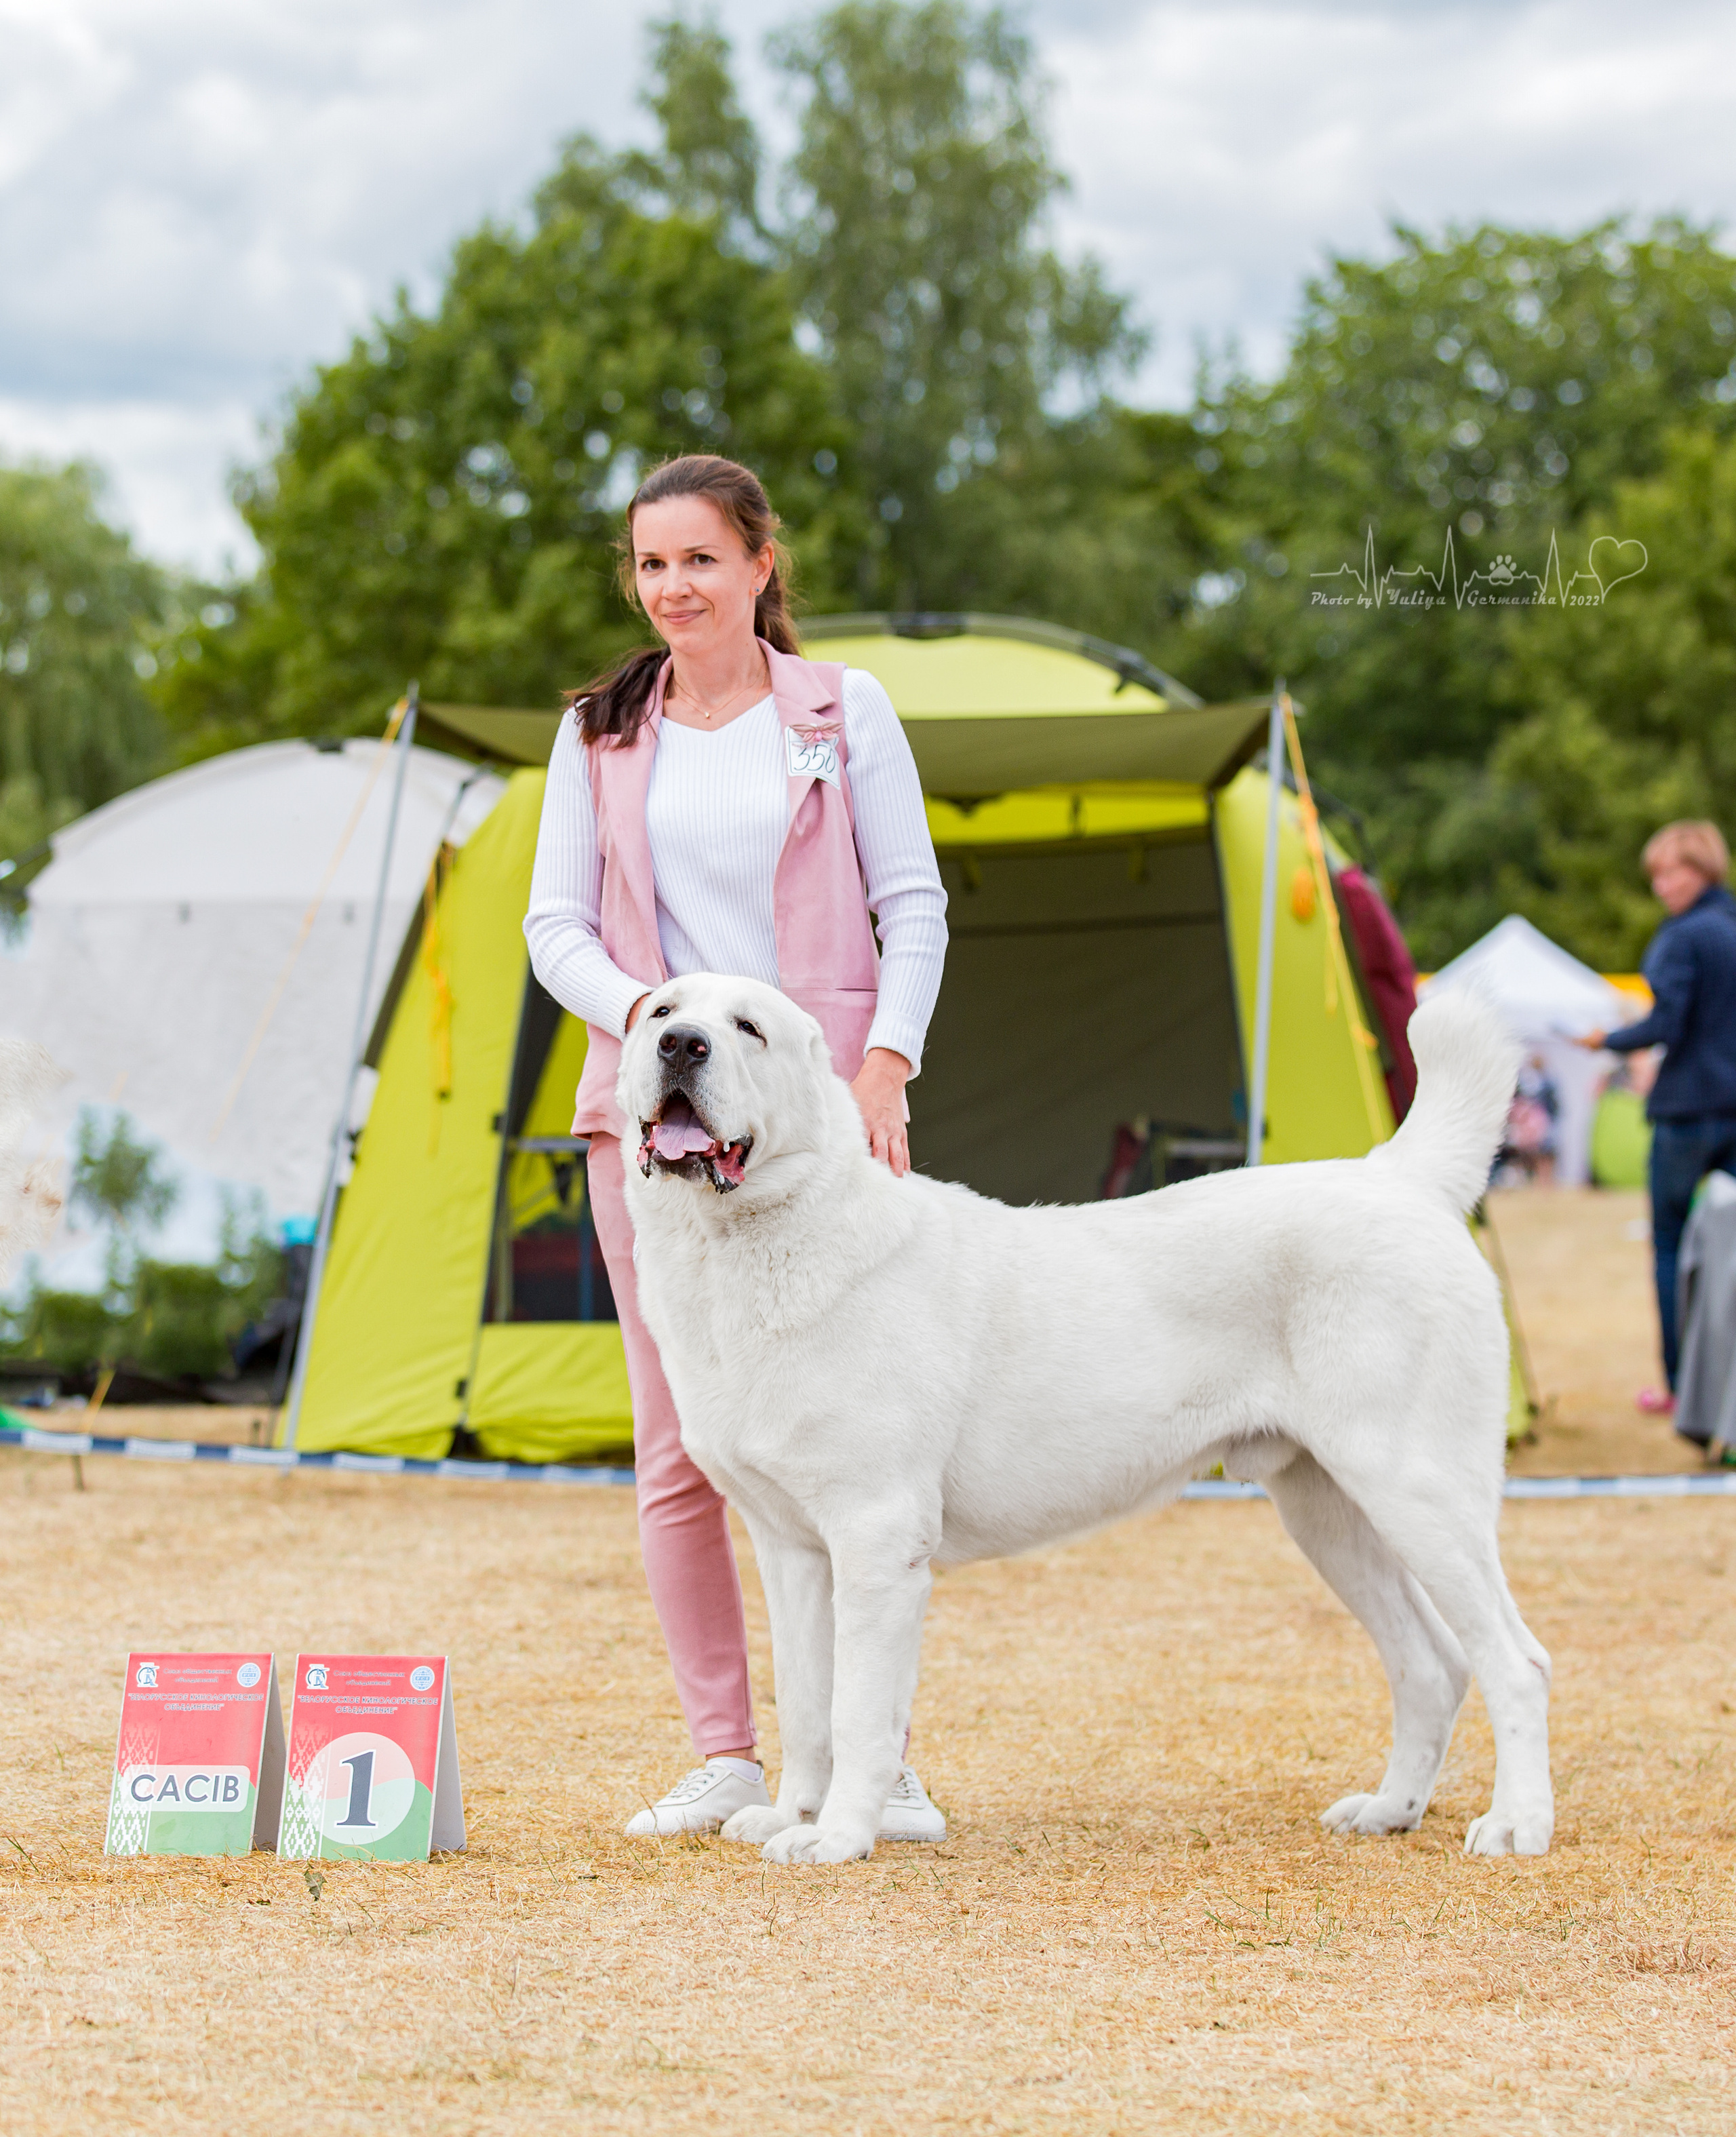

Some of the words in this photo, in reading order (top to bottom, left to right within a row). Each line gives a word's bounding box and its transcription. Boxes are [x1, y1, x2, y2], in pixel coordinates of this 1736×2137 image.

[793, 743, 836, 774] 350
[189, 1693, 264, 1702] КИНОЛОГИЧЕСКОЕ
[361, 1696, 439, 1705] КИНОЛОГИЧЕСКОЕ
[164, 1703, 225, 1712] ОБЪЕДИНЕНИЕ"
[335, 1706, 398, 1714] ОБЪЕДИНЕНИЕ"
[131, 1774, 240, 1802] CACIB
[336, 1751, 376, 1826] 1
